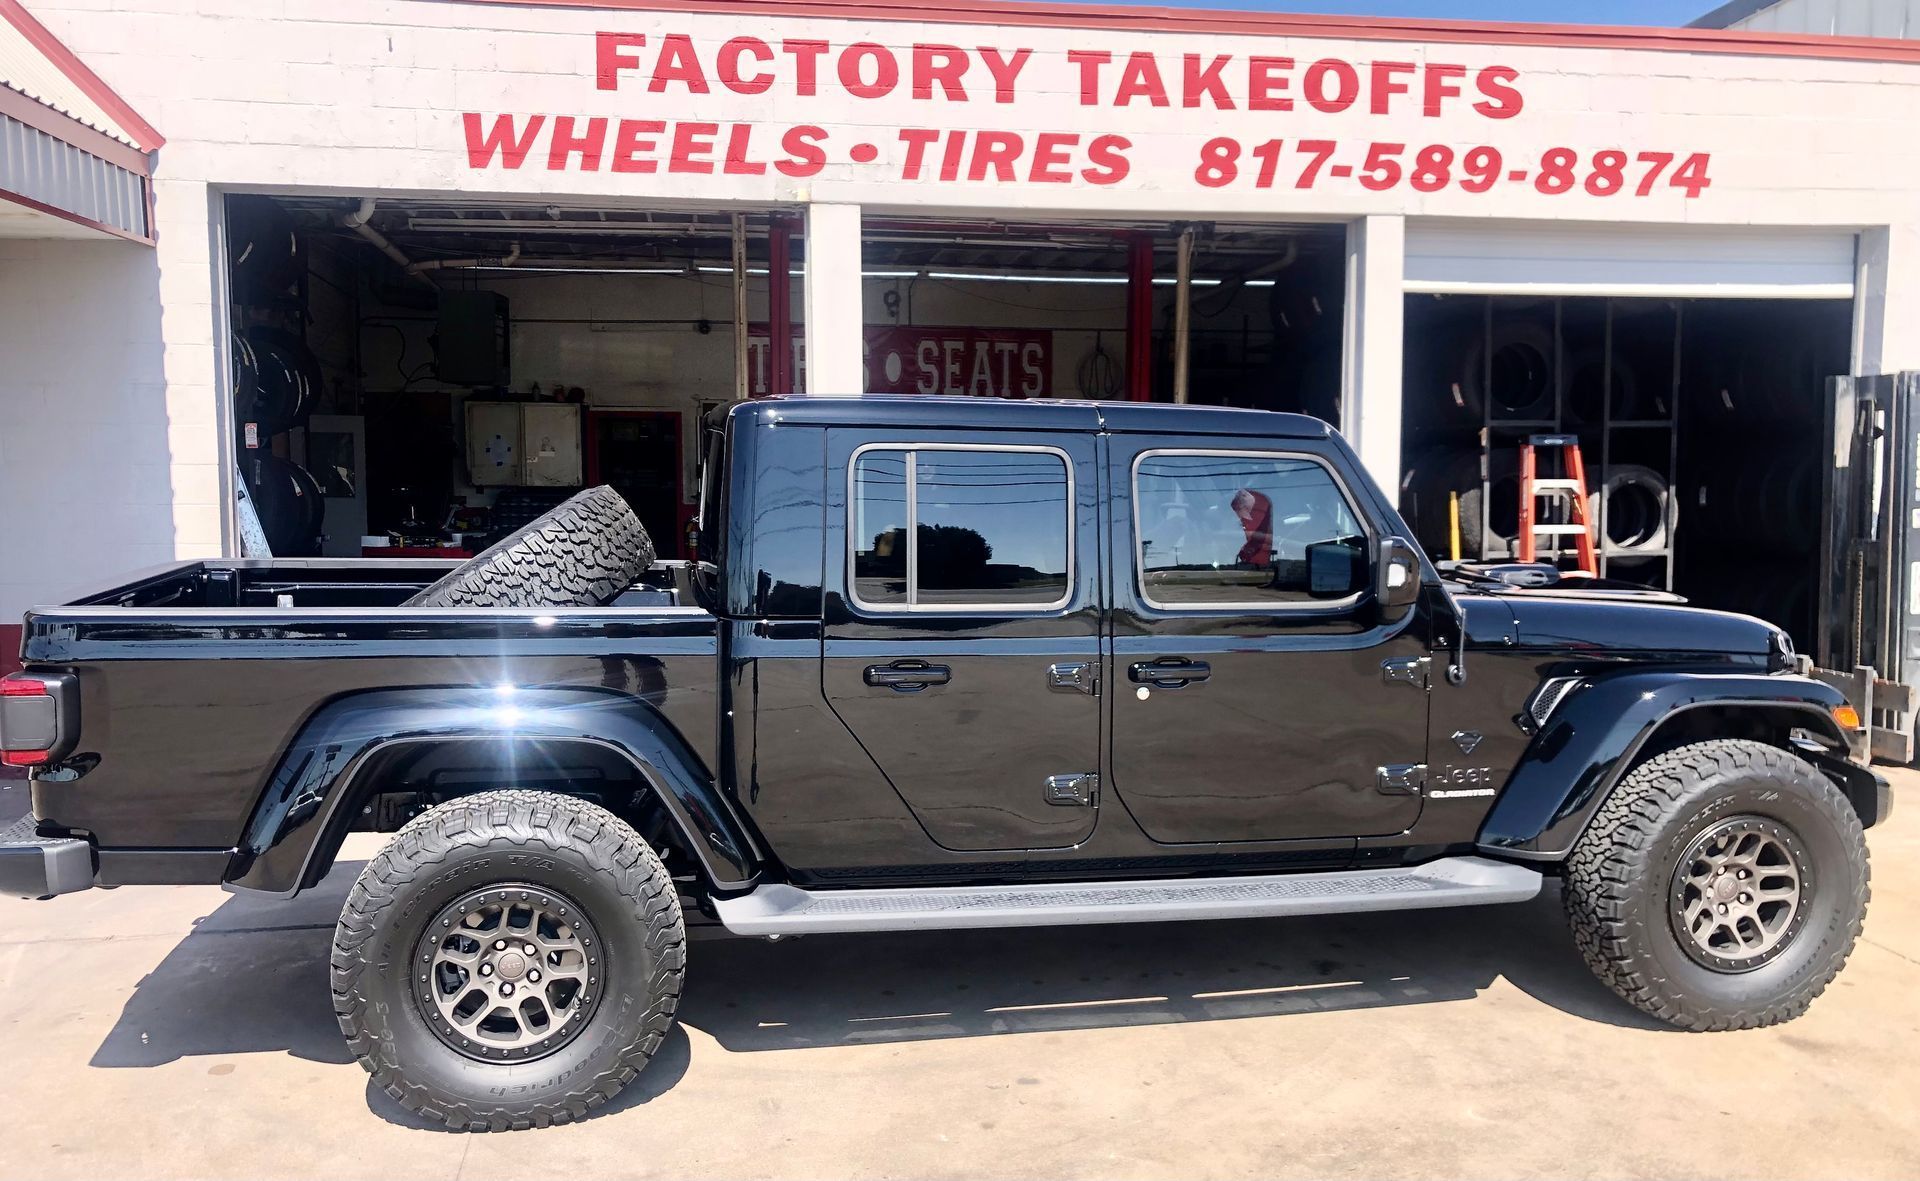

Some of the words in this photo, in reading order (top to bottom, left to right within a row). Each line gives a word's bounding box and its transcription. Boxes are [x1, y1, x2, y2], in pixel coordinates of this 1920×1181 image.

[596, 32, 1032, 104] FACTORY
[1067, 50, 1524, 119] TAKEOFFS
[462, 113, 829, 178] WHEELS
[898, 129, 1133, 185] TIRES
[1194, 137, 1712, 198] 817-589-8874
[917, 340, 1044, 398] SEATS
